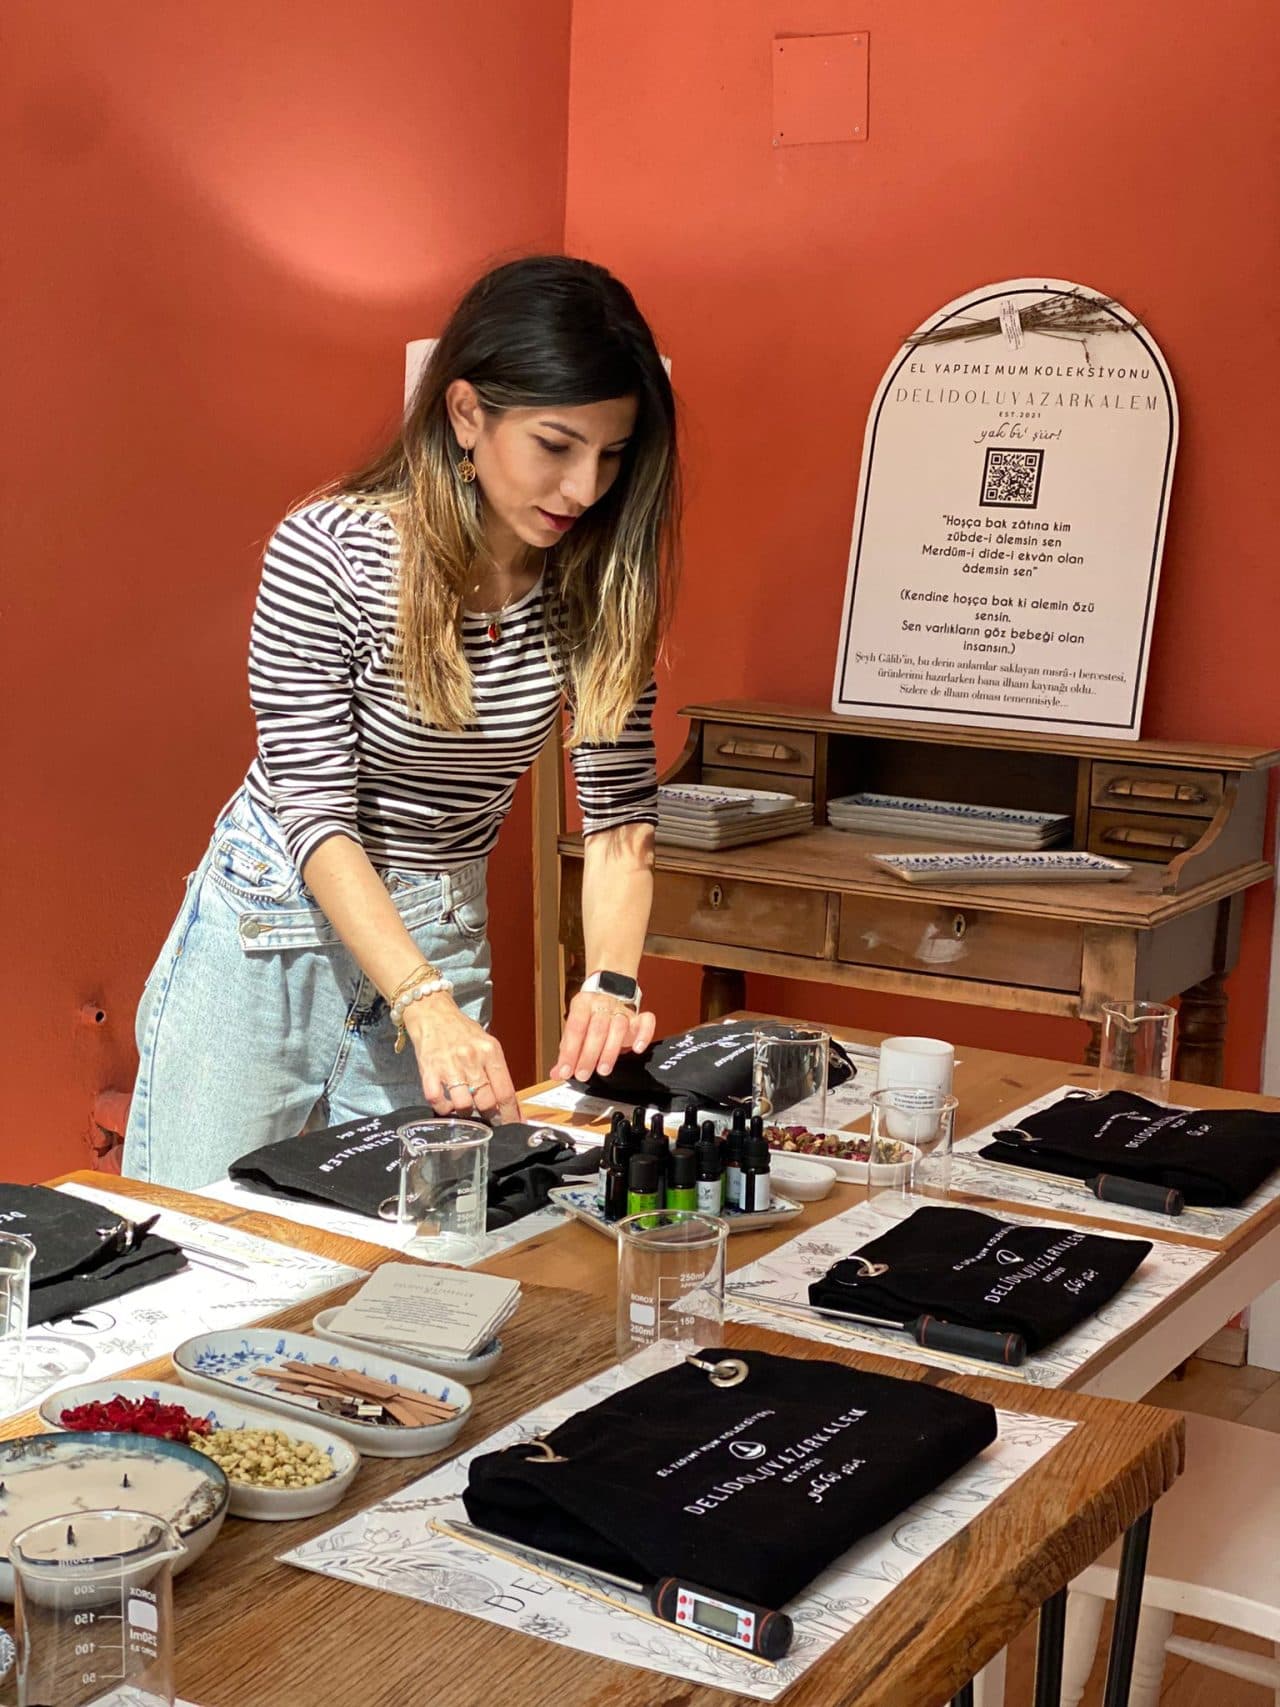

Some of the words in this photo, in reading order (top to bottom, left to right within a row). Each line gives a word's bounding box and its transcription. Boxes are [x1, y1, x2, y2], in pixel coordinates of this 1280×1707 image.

[910, 363, 926, 374] EL
[935, 363, 991, 375] YAPIMI
[995, 365, 1029, 376] MUM
[1034, 365, 1151, 379] KOLEKSİYONU
[973, 421, 1011, 444] yak
[985, 516, 1008, 529] bak
[1012, 519, 1050, 532] zâtına
[1053, 521, 1071, 532] kim
[996, 533, 1038, 546] âlemsin
[1042, 538, 1063, 548] sen
[1057, 552, 1084, 565] olan
[962, 562, 1009, 576] âdemsin
[900, 588, 949, 603] (Kendine
[952, 592, 988, 607] hoşça
[991, 594, 1014, 608] bak
[1018, 595, 1027, 608] ki
[1031, 598, 1069, 612] alemin
[1072, 601, 1095, 613] özü
[975, 610, 1012, 623] sensin.
[901, 620, 922, 632] Sen
[925, 622, 980, 636] varlıkların
[984, 626, 1007, 639] göz
[1010, 628, 1055, 643] bebeği
[1058, 632, 1085, 644] olan
[963, 640, 1016, 655] insansın.)
[917, 656, 931, 666] bu
[931, 656, 955, 668] derin
[956, 659, 998, 672] anlamlar
[999, 662, 1040, 677] saklayan
[925, 670, 975, 684] hazırlarken
[977, 674, 1000, 687] bana
[1002, 677, 1029, 689] ilham
[1031, 679, 1068, 695] kaynağı
[899, 684, 929, 696] Sizlere
[930, 685, 942, 696] de
[944, 687, 970, 699] ilham
[971, 690, 1001, 702] olması
[680, 1272, 706, 1282] 250ml
[680, 1317, 696, 1326] 150
[630, 1323, 655, 1337] 250ml
